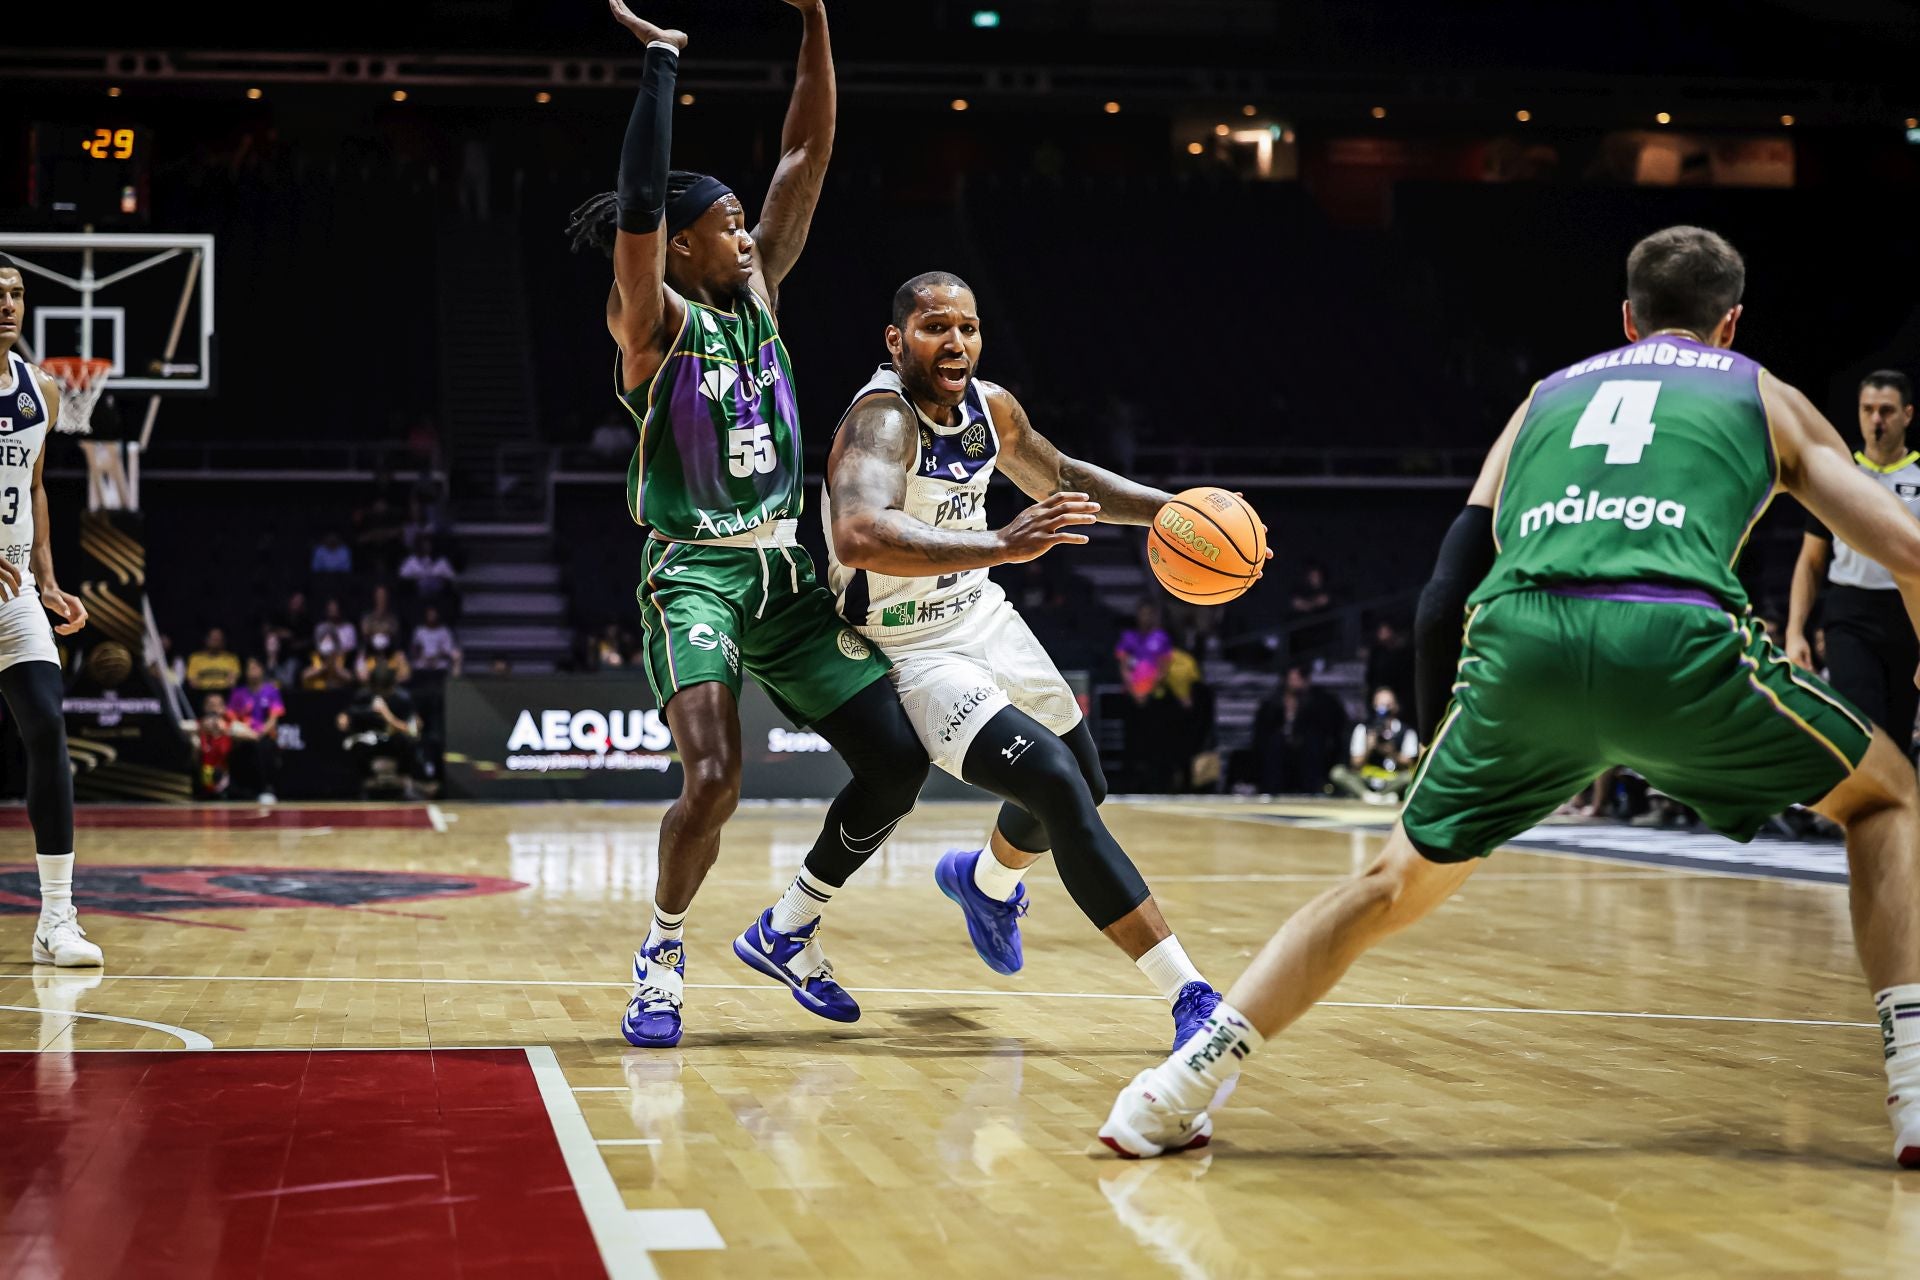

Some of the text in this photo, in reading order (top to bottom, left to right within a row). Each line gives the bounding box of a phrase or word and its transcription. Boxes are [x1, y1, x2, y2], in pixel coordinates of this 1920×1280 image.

[1565, 343, 1734, 379] KALINOSKI
[1569, 380, 1662, 464] 4
[728, 422, 777, 479] 55
[1160, 506, 1220, 562] Wilson
[506, 709, 672, 754] AEQUS
